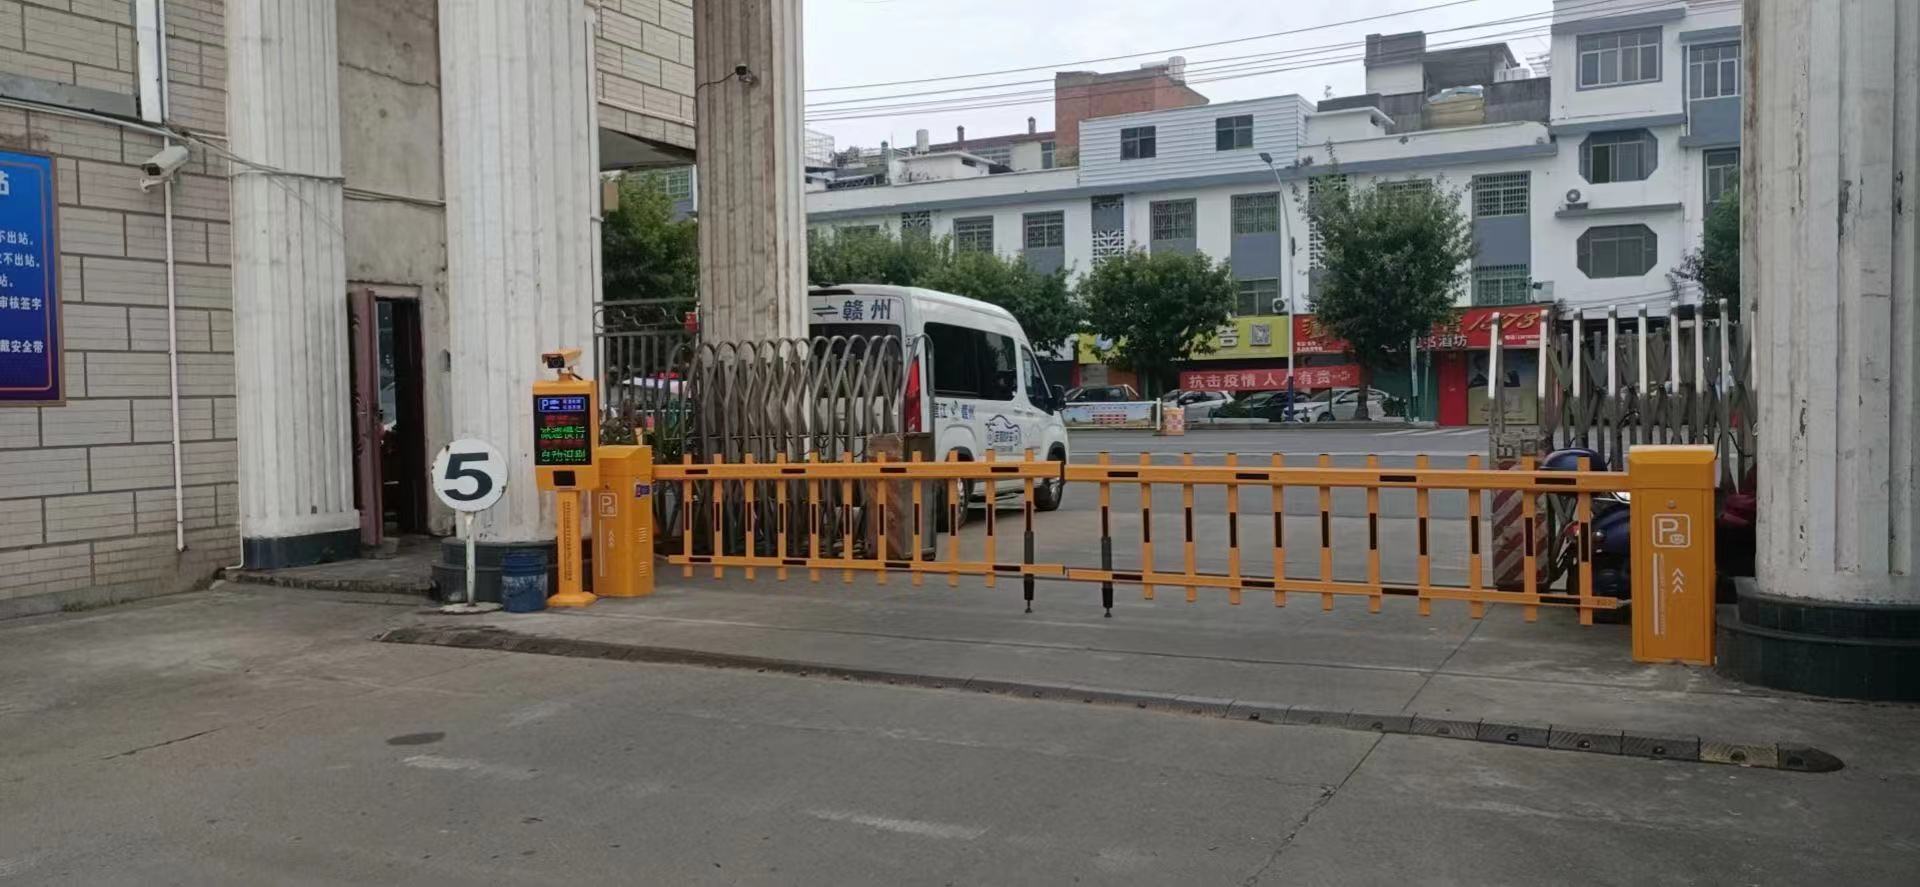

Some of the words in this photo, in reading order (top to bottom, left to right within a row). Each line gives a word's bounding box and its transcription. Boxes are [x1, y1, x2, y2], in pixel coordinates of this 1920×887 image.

[0, 252, 40, 268] 不出站。
[843, 298, 891, 321] 赣州
[1189, 373, 1256, 389] 抗击疫情
[443, 452, 493, 501] 5
